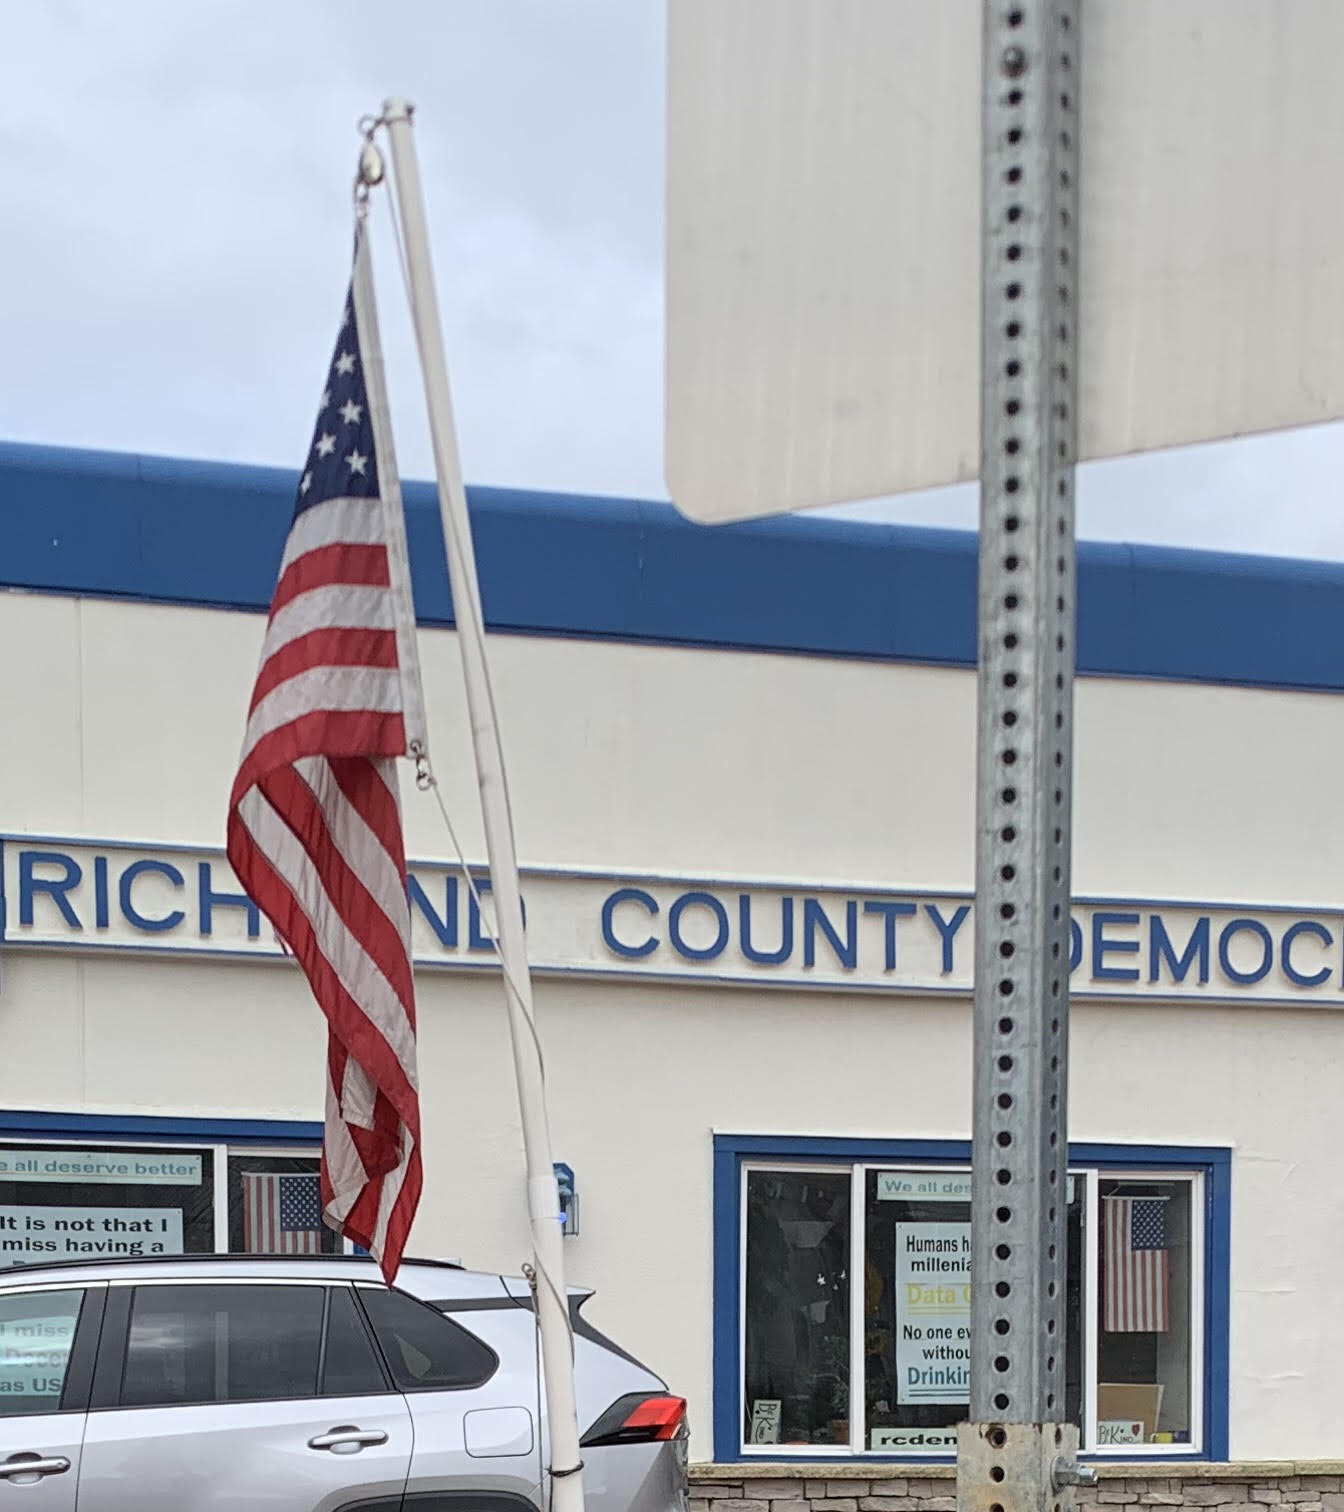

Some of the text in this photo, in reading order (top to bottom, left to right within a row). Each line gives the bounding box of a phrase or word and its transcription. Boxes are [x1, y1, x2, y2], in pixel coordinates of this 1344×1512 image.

[19, 851, 525, 949] RICHND
[602, 887, 971, 974] COUNTY
[15, 1159, 38, 1172] all
[45, 1160, 128, 1174] deserve
[135, 1162, 197, 1176] better
[885, 1181, 912, 1193] We
[918, 1182, 937, 1193] all
[0, 1216, 167, 1232] It is not that I
[2, 1238, 164, 1256] miss having a
[906, 1235, 958, 1252] Humans
[908, 1283, 956, 1304] Data
[16, 1323, 69, 1337] miss
[903, 1325, 922, 1339] No
[927, 1328, 953, 1339] one
[922, 1345, 971, 1360] withou
[908, 1367, 971, 1385] Drinkin
[0, 1381, 25, 1392] as
